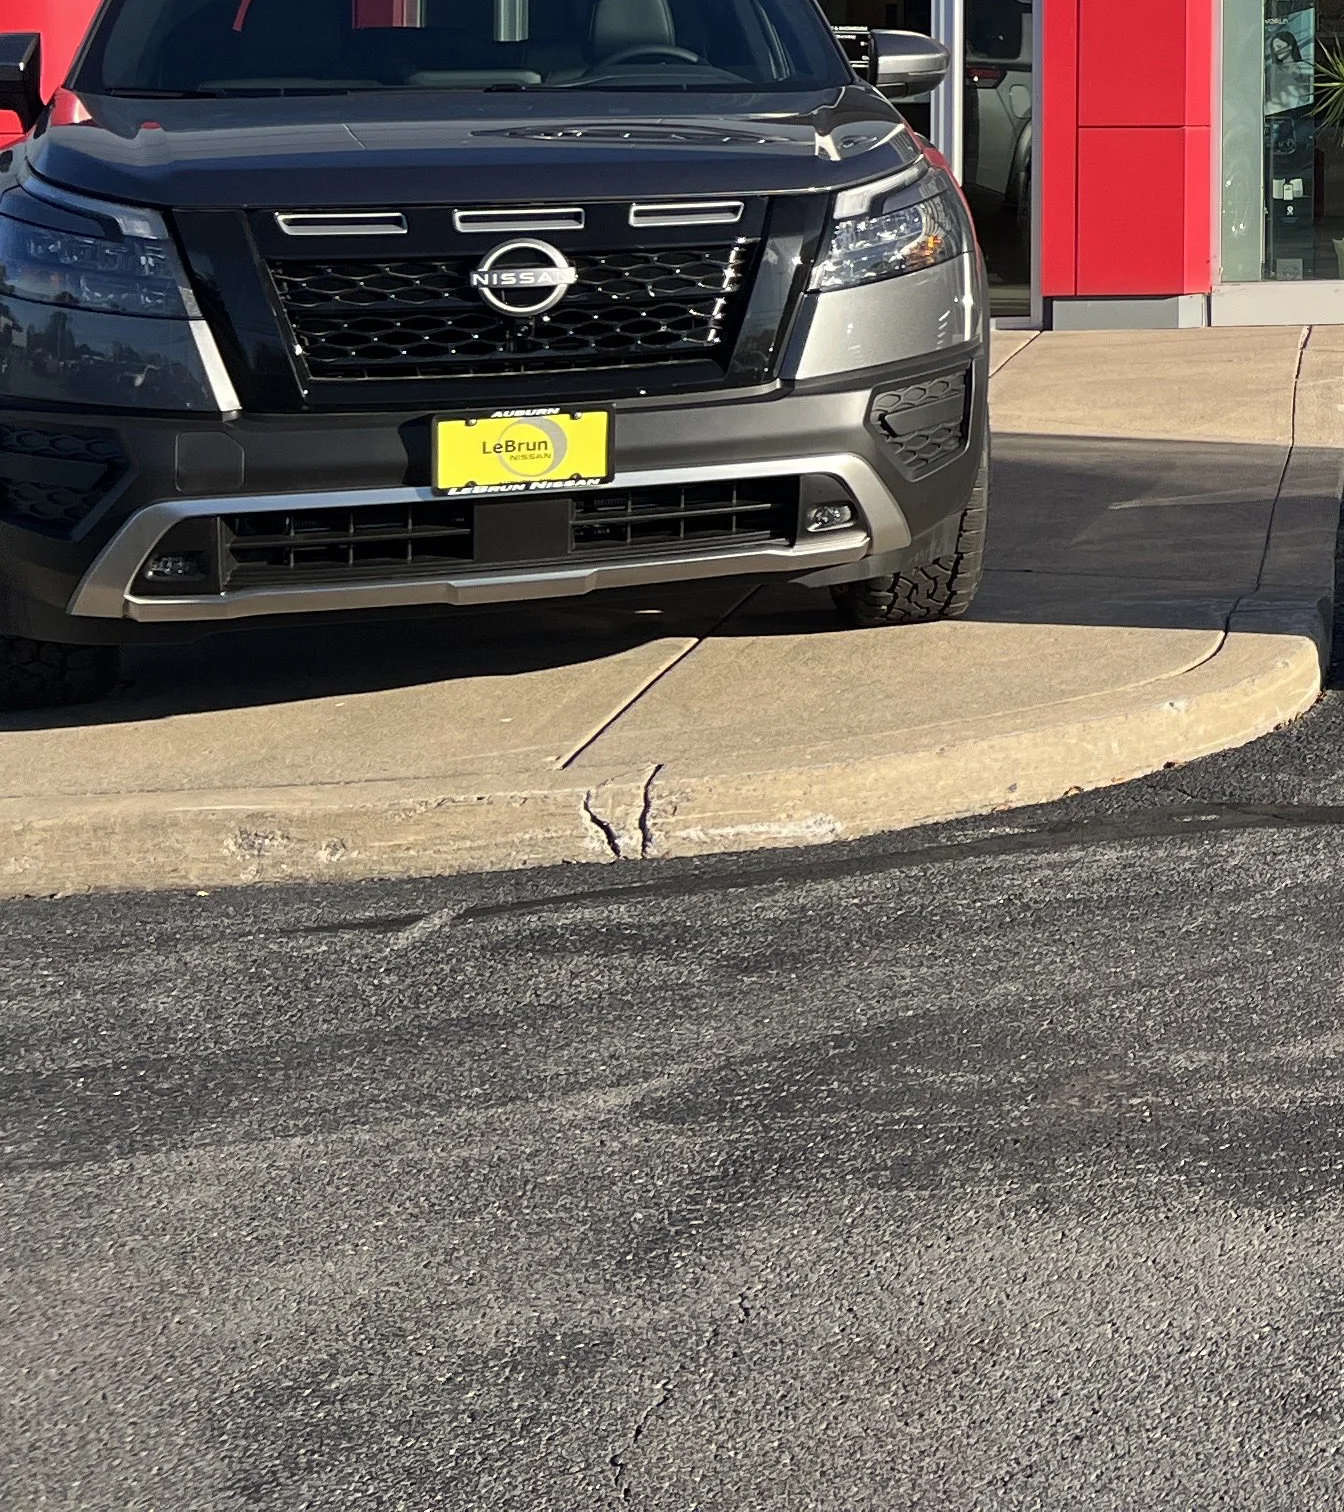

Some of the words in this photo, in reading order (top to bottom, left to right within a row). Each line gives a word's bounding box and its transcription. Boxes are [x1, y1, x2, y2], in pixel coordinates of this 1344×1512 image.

[490, 407, 561, 418] AUBURN
[482, 439, 549, 455] LeBrun
[509, 453, 552, 461] NISSAN
[530, 478, 601, 491] NISSAN
